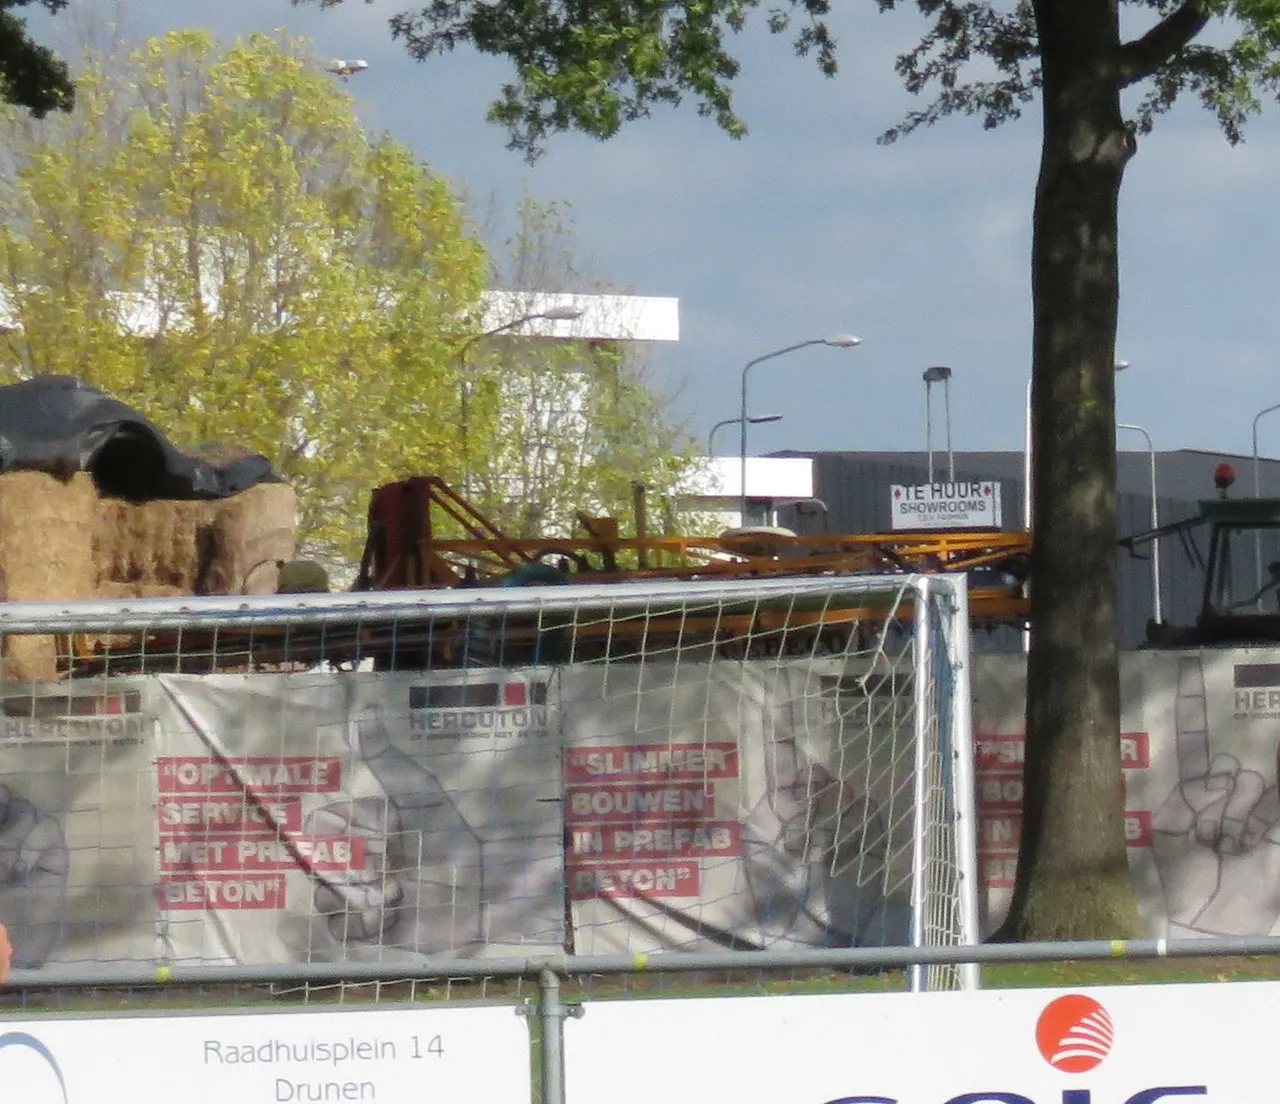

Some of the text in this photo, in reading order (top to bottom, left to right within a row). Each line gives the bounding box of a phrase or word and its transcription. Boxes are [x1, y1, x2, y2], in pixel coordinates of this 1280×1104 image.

[905, 482, 982, 500] TE HUUR
[900, 500, 986, 514] SHOWROOMS
[571, 788, 705, 815] BOUWEN
[614, 827, 732, 853] PREFAB
[164, 841, 228, 864] MET
[204, 1034, 446, 1067] Raadhuisplein 14
[274, 1078, 376, 1102] Drunen
